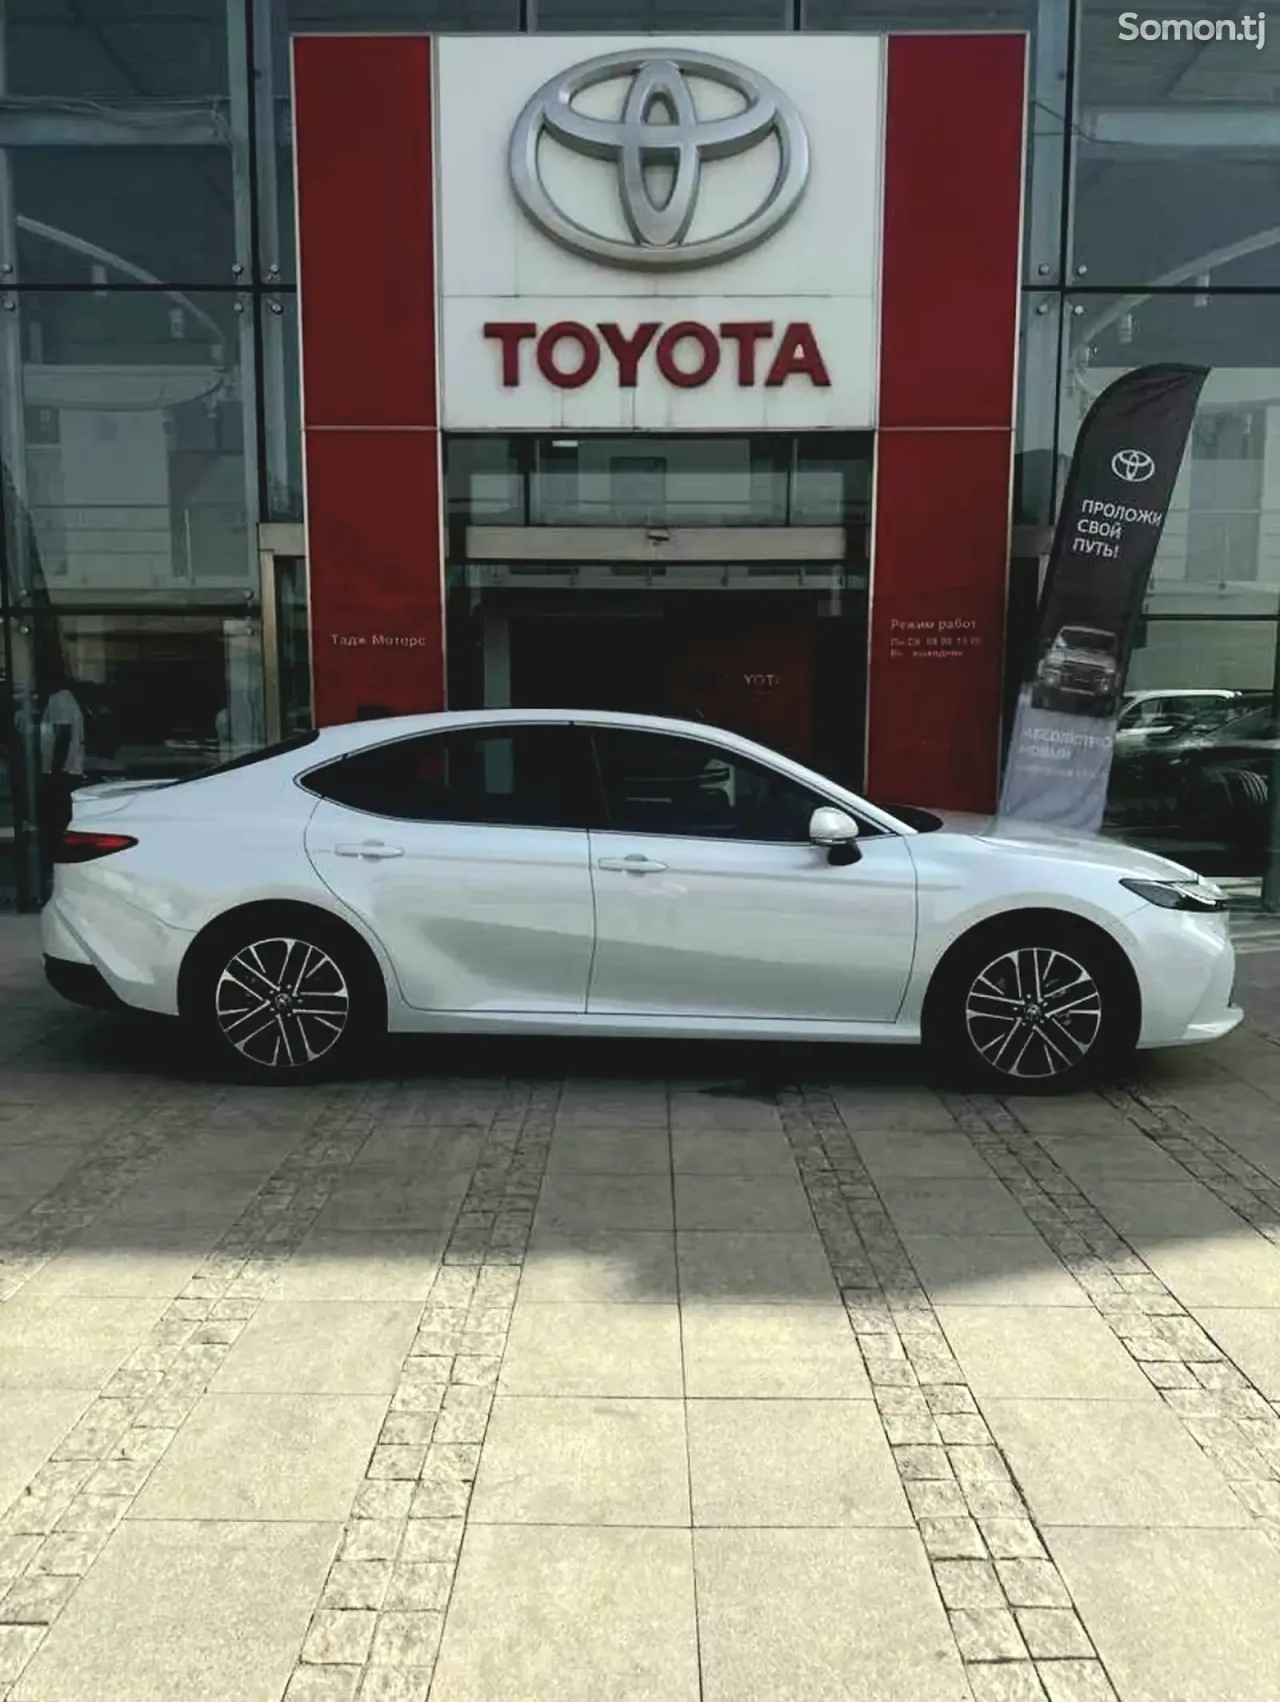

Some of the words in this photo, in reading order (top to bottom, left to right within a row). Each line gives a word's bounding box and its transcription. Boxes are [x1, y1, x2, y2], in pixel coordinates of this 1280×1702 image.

[484, 321, 831, 388] TOYOTA
[1081, 499, 1163, 527] ПРОЛОЖИ
[1077, 519, 1122, 539] СВОЙ
[1072, 539, 1120, 559] ПУТЬ!
[371, 634, 427, 648] Моторс
